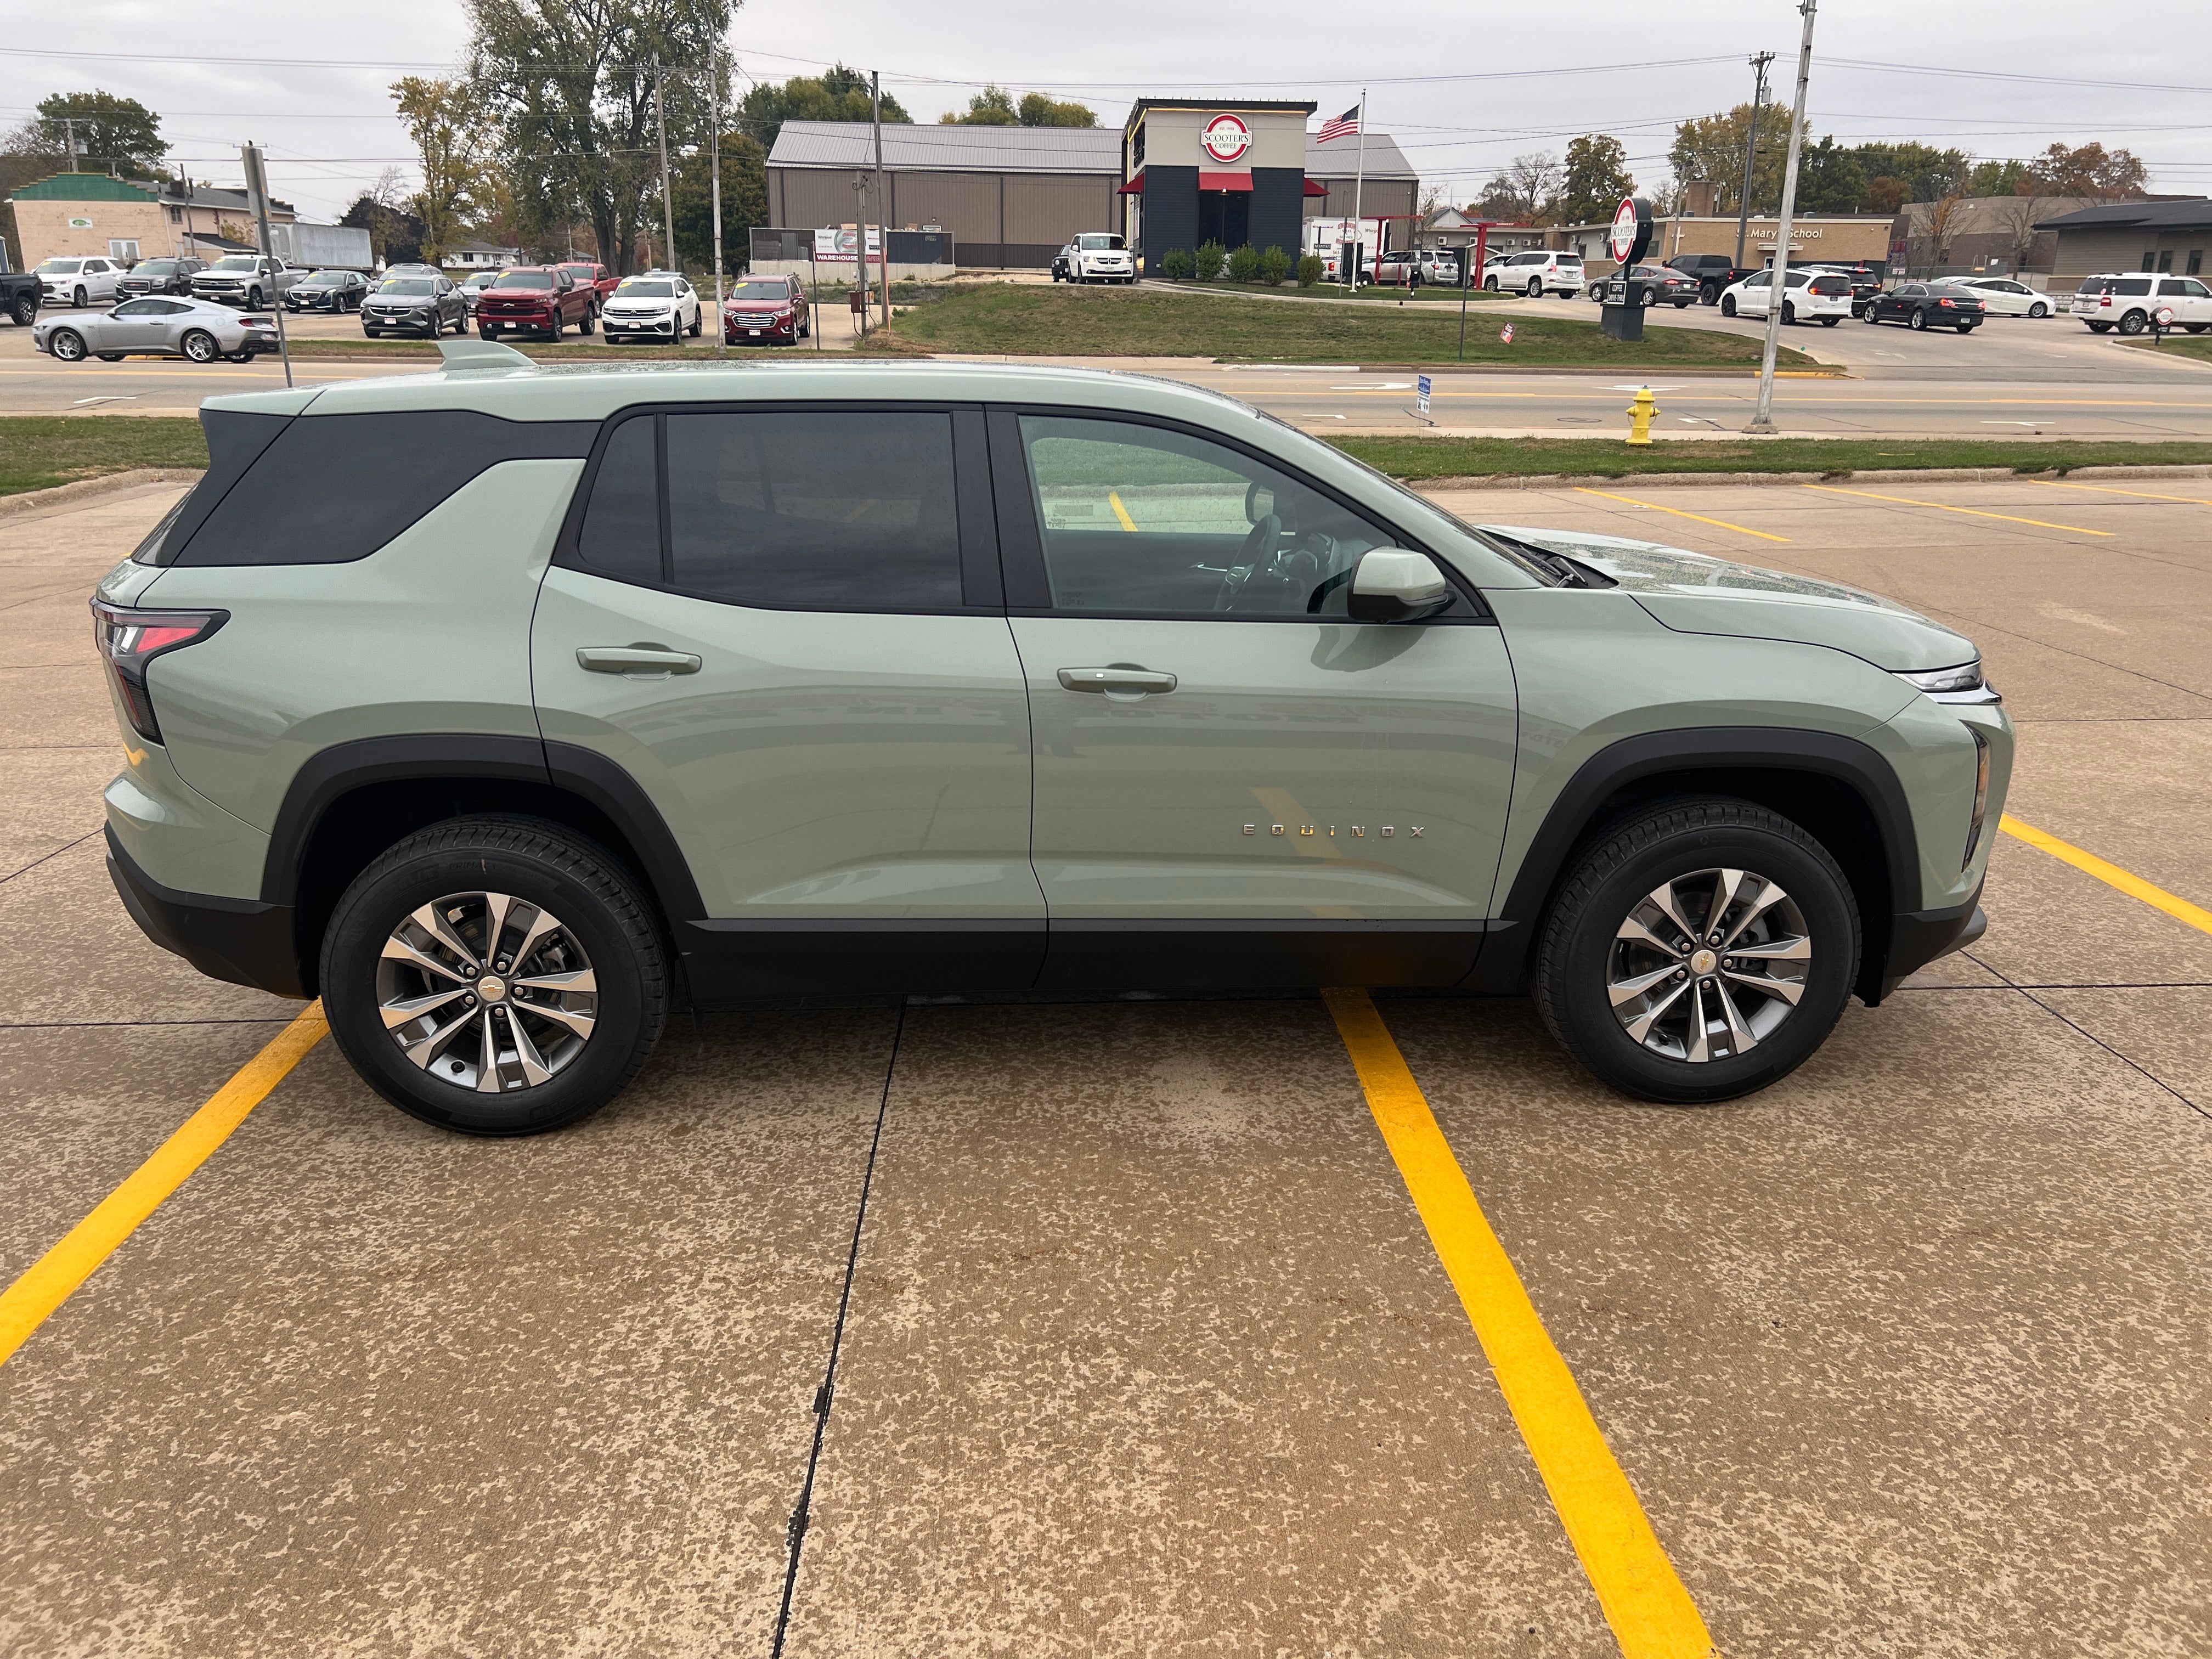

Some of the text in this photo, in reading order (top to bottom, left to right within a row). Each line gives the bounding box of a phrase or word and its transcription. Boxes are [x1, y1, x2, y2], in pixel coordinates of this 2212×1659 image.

[1205, 134, 1249, 143] SCOOTER'S
[1790, 228, 1823, 238] School
[1242, 823, 1425, 838] EQUINOX
